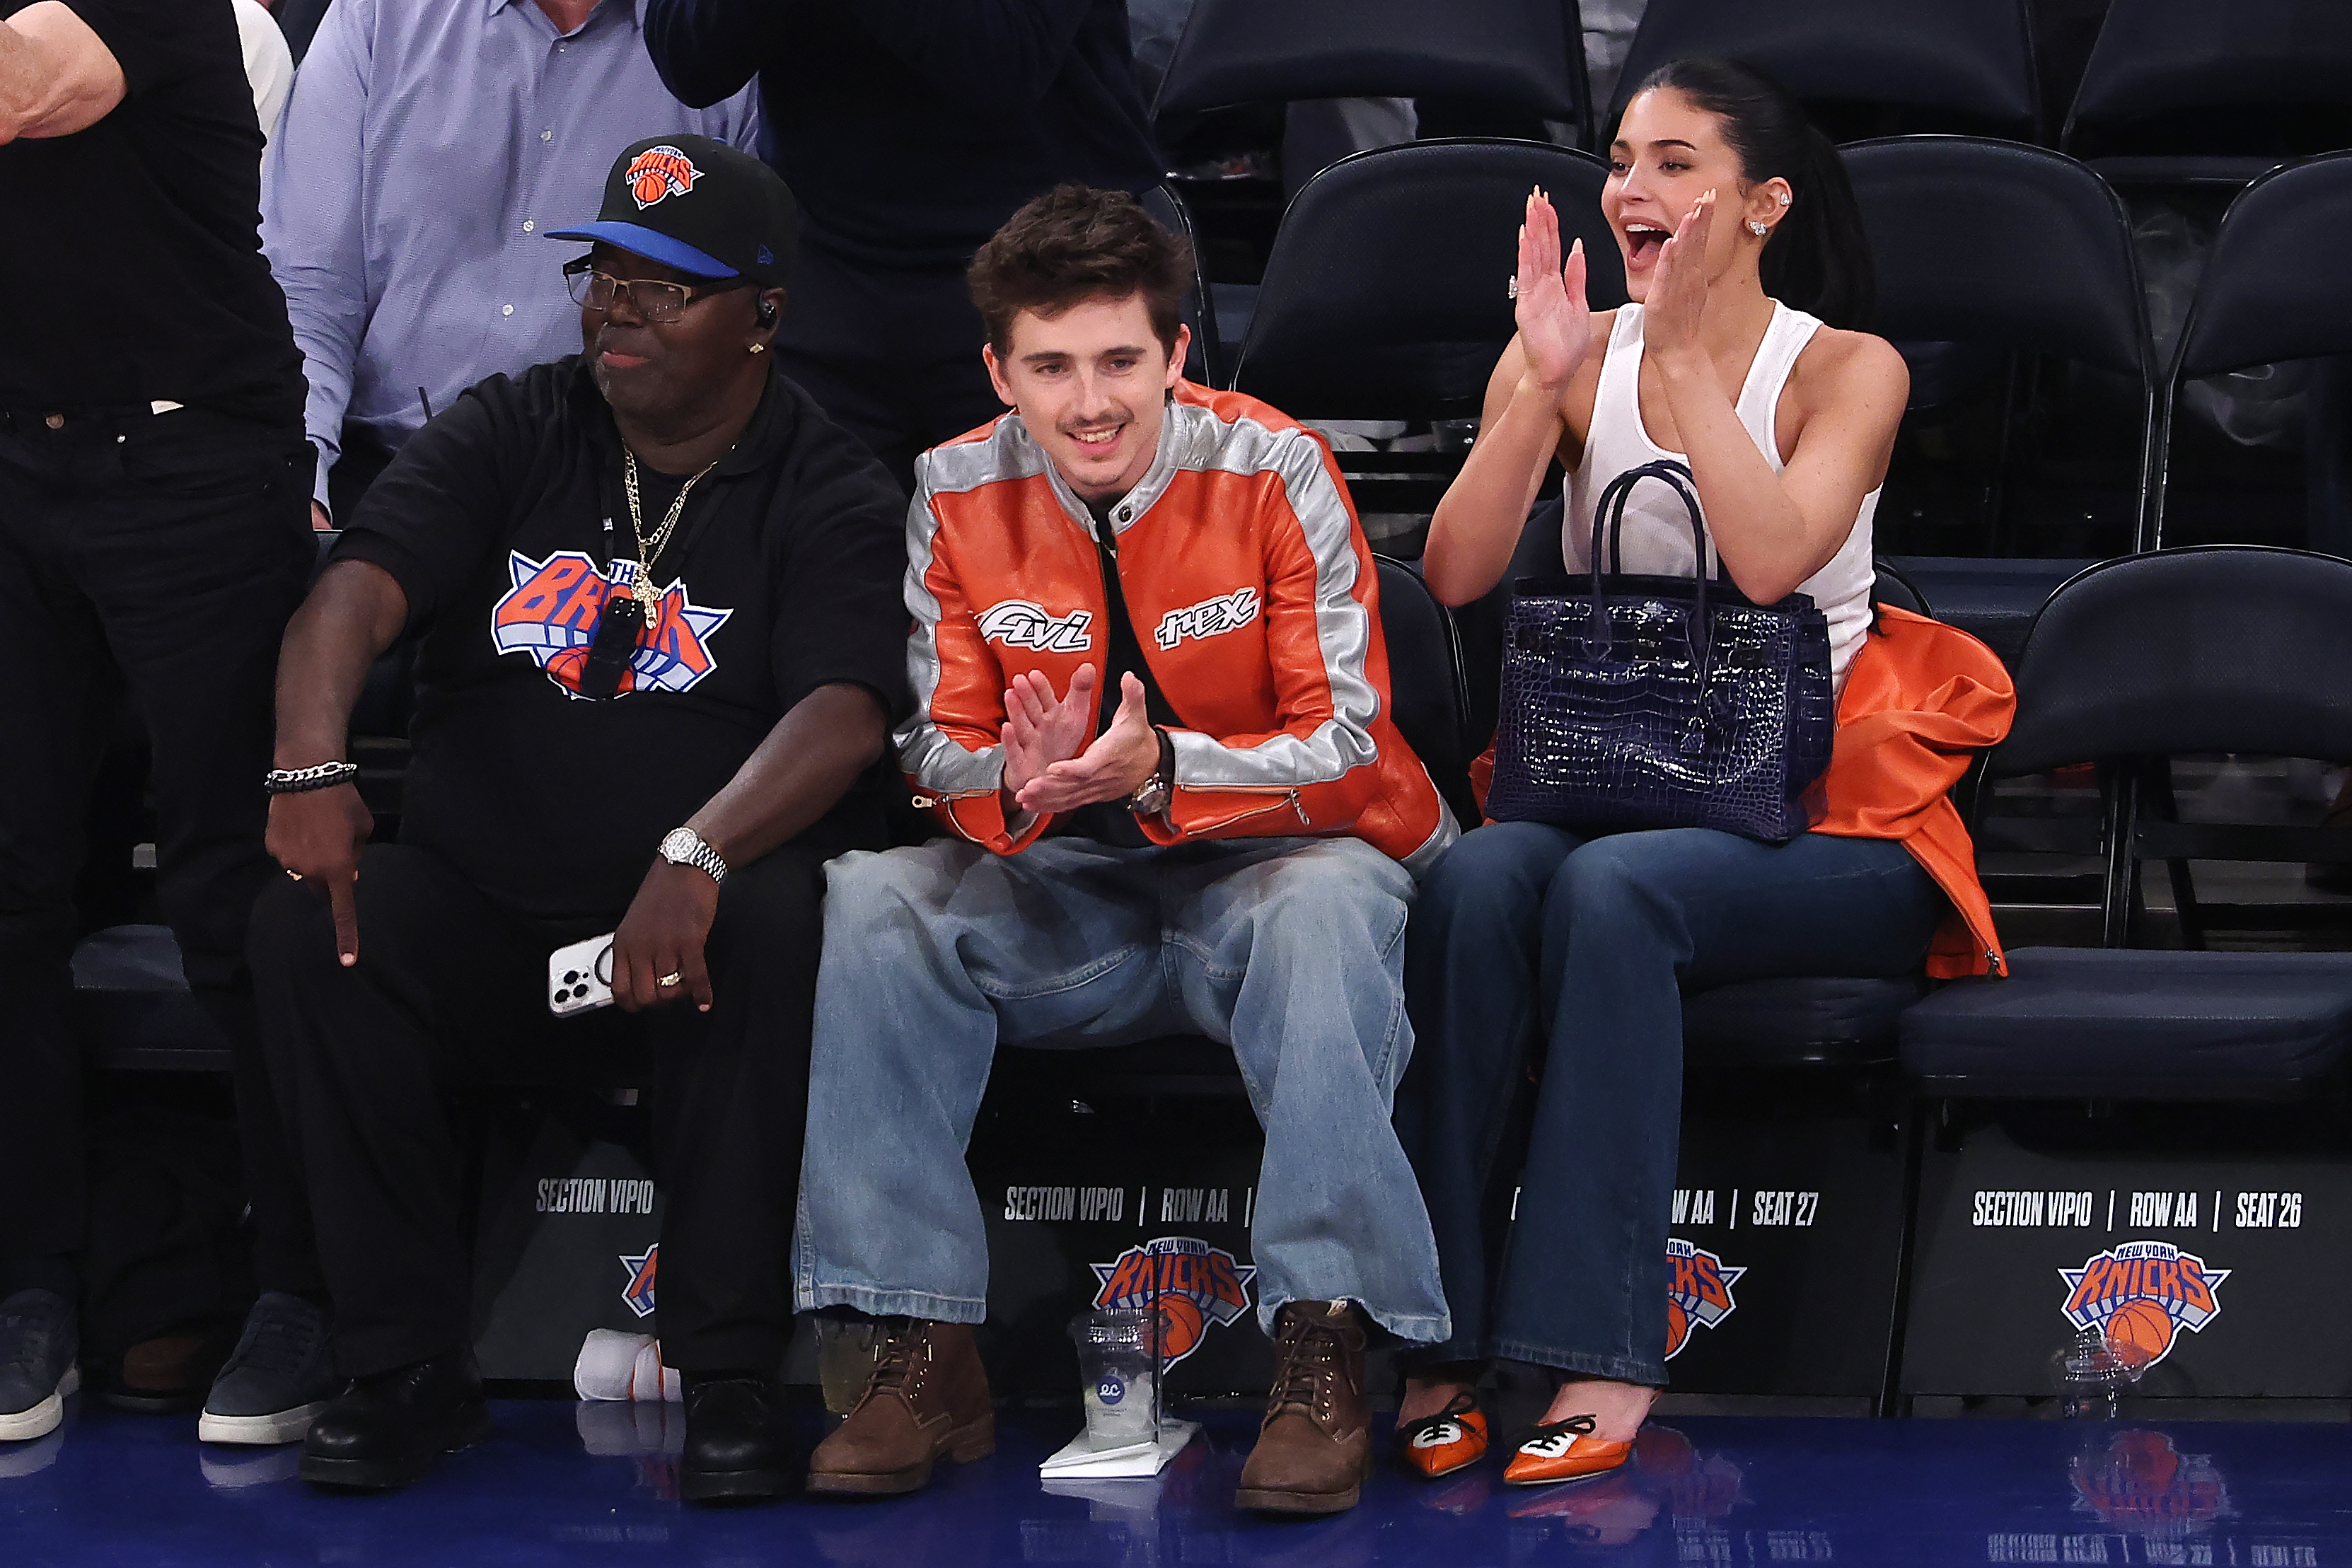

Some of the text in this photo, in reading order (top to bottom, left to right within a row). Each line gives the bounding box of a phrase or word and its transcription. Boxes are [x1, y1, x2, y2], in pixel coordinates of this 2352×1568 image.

[626, 151, 691, 189] KNICKS
[610, 562, 637, 583] TH
[535, 1178, 607, 1213] SECTION
[1004, 1186, 1076, 1221] SECTION
[1161, 1187, 1204, 1223] ROW
[1205, 1188, 1229, 1223] AA
[1691, 1190, 1715, 1224] AA
[1752, 1190, 1795, 1226] SEAT
[1795, 1191, 1819, 1226] 27
[1972, 1190, 2302, 1228] SECTION VIP10 ROW AA SEAT 26
[1147, 1240, 1174, 1255] NEW
[1668, 1240, 1692, 1257] ORK
[2117, 1245, 2175, 1260] NEW YORK
[1099, 1251, 1246, 1308] KNICKS
[2067, 1257, 2215, 1313] KNICKS
